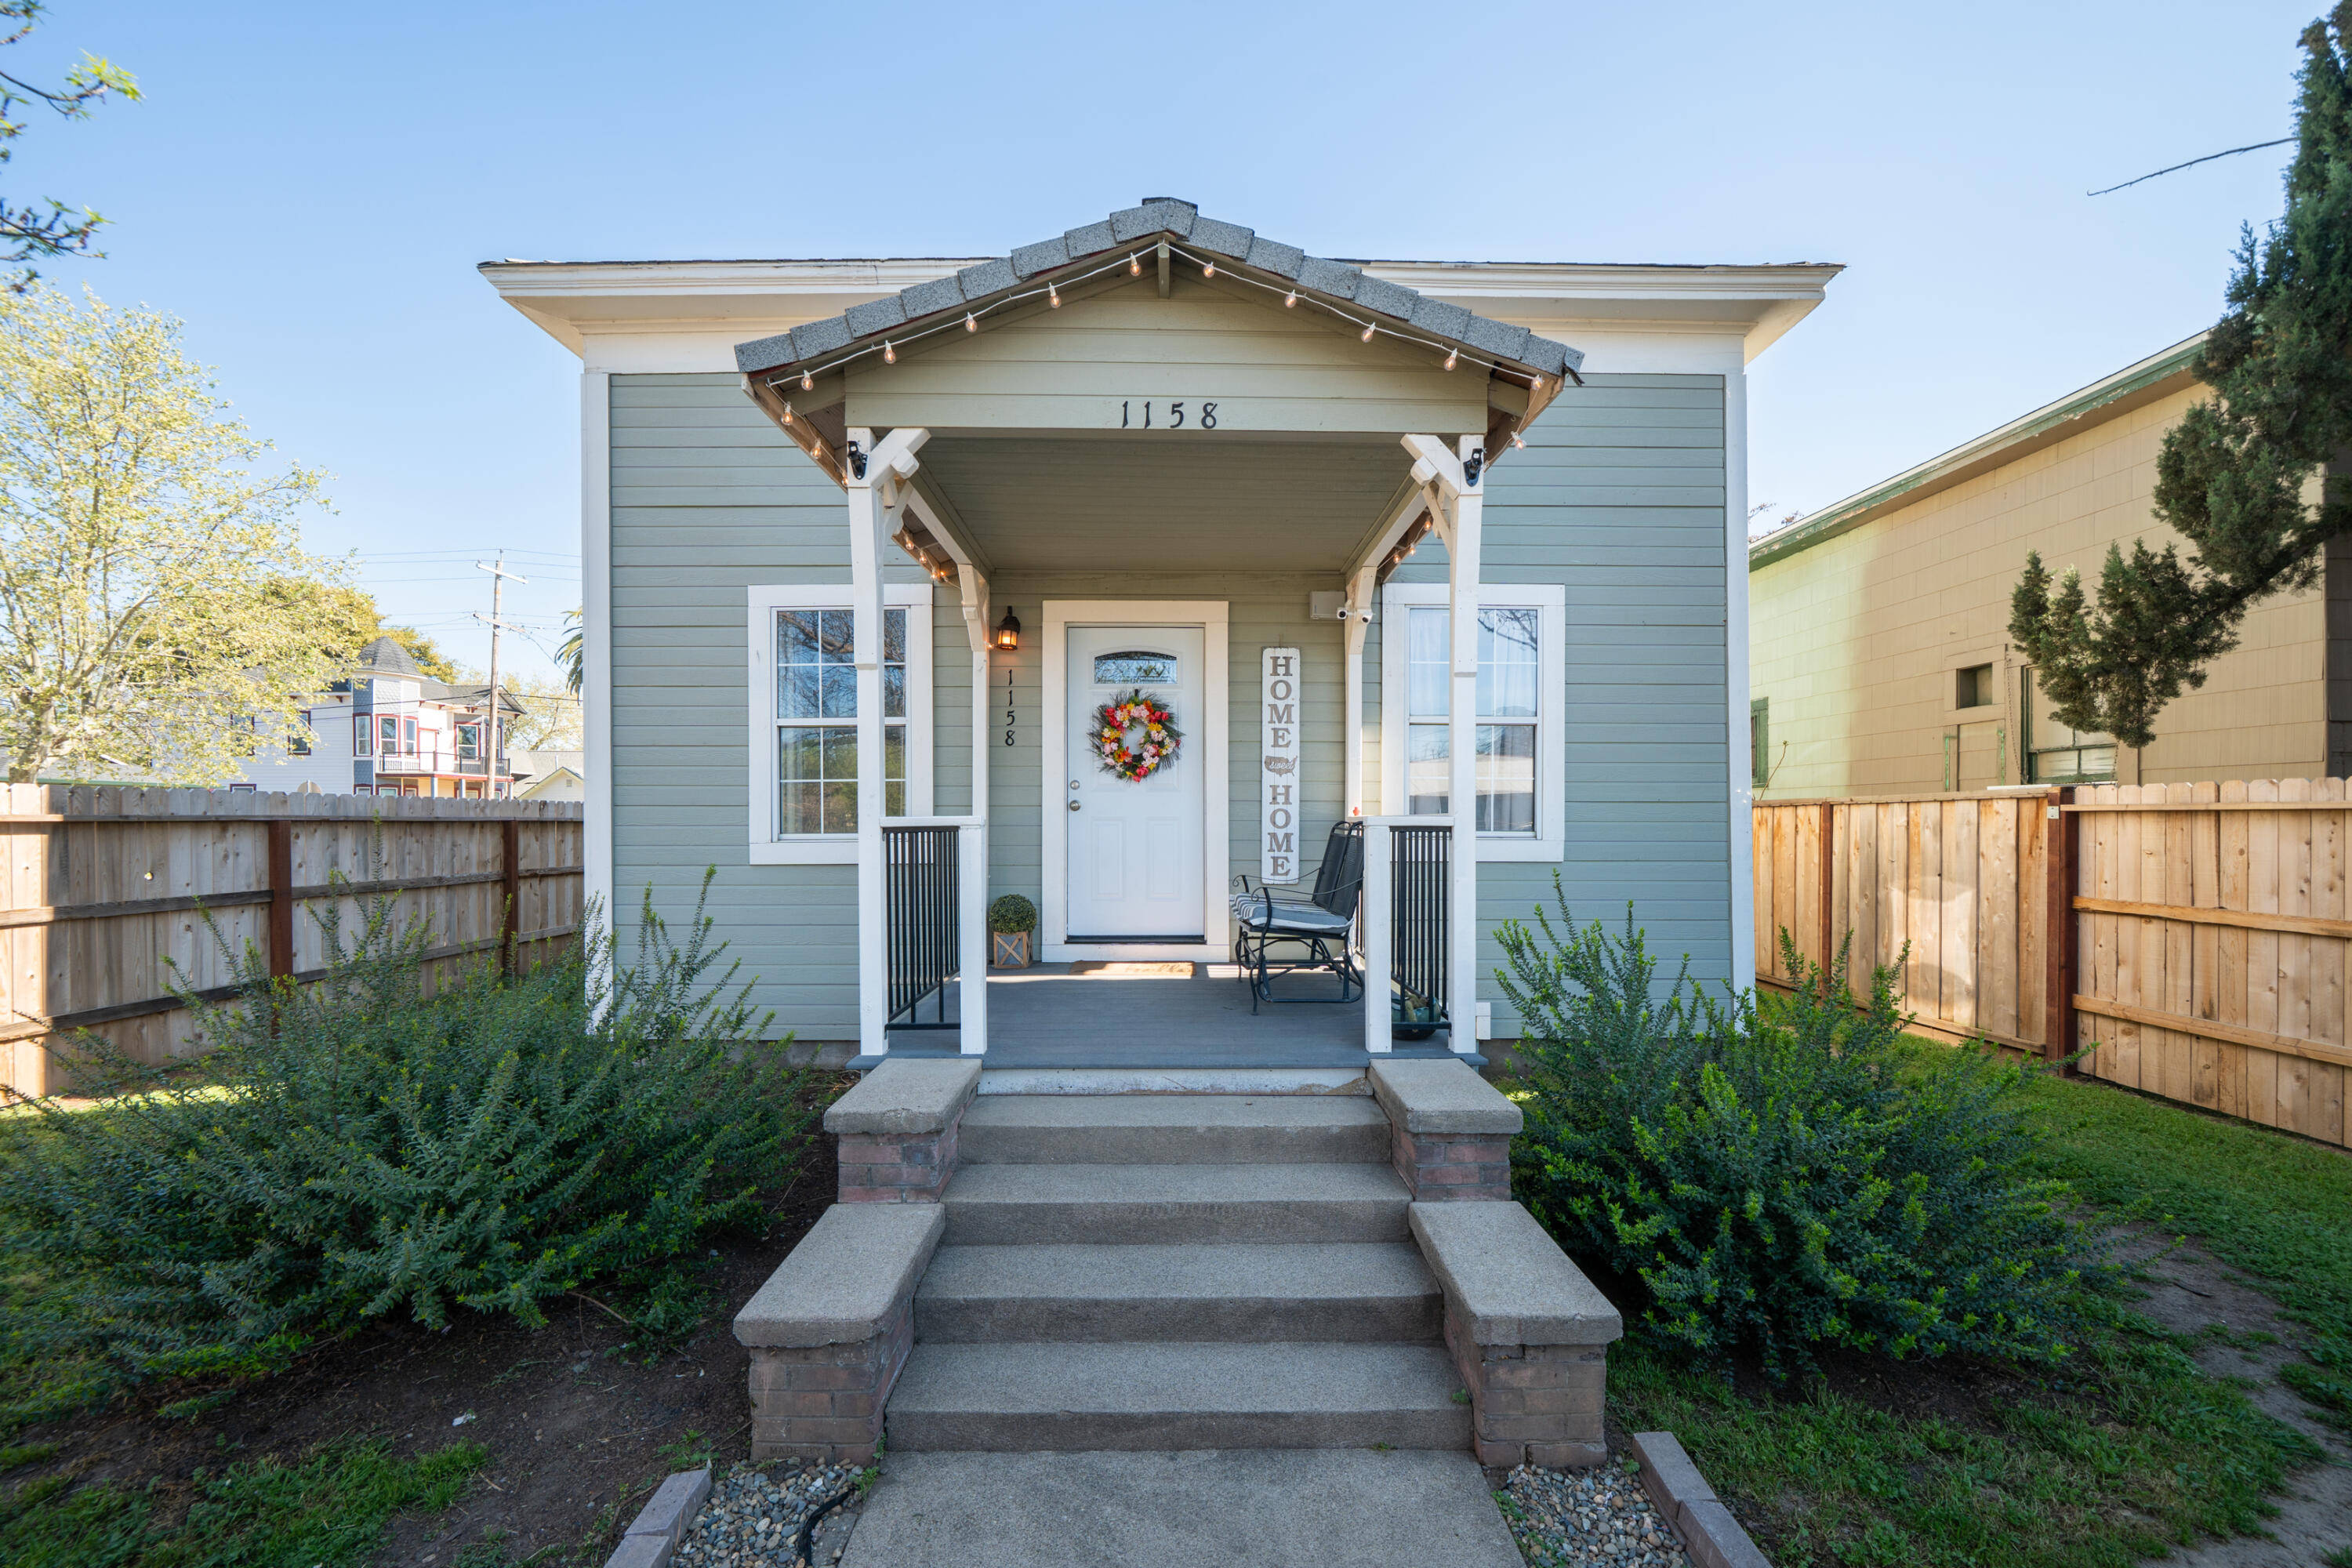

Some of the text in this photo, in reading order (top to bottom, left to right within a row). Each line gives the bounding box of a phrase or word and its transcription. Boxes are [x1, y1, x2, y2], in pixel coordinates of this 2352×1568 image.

[1122, 401, 1218, 429] 1158
[1005, 669, 1015, 746] 1158
[1268, 656, 1294, 748] HOME
[1269, 759, 1294, 770] sweet
[1267, 785, 1294, 877] HOME
[769, 1446, 800, 1456] MADE
